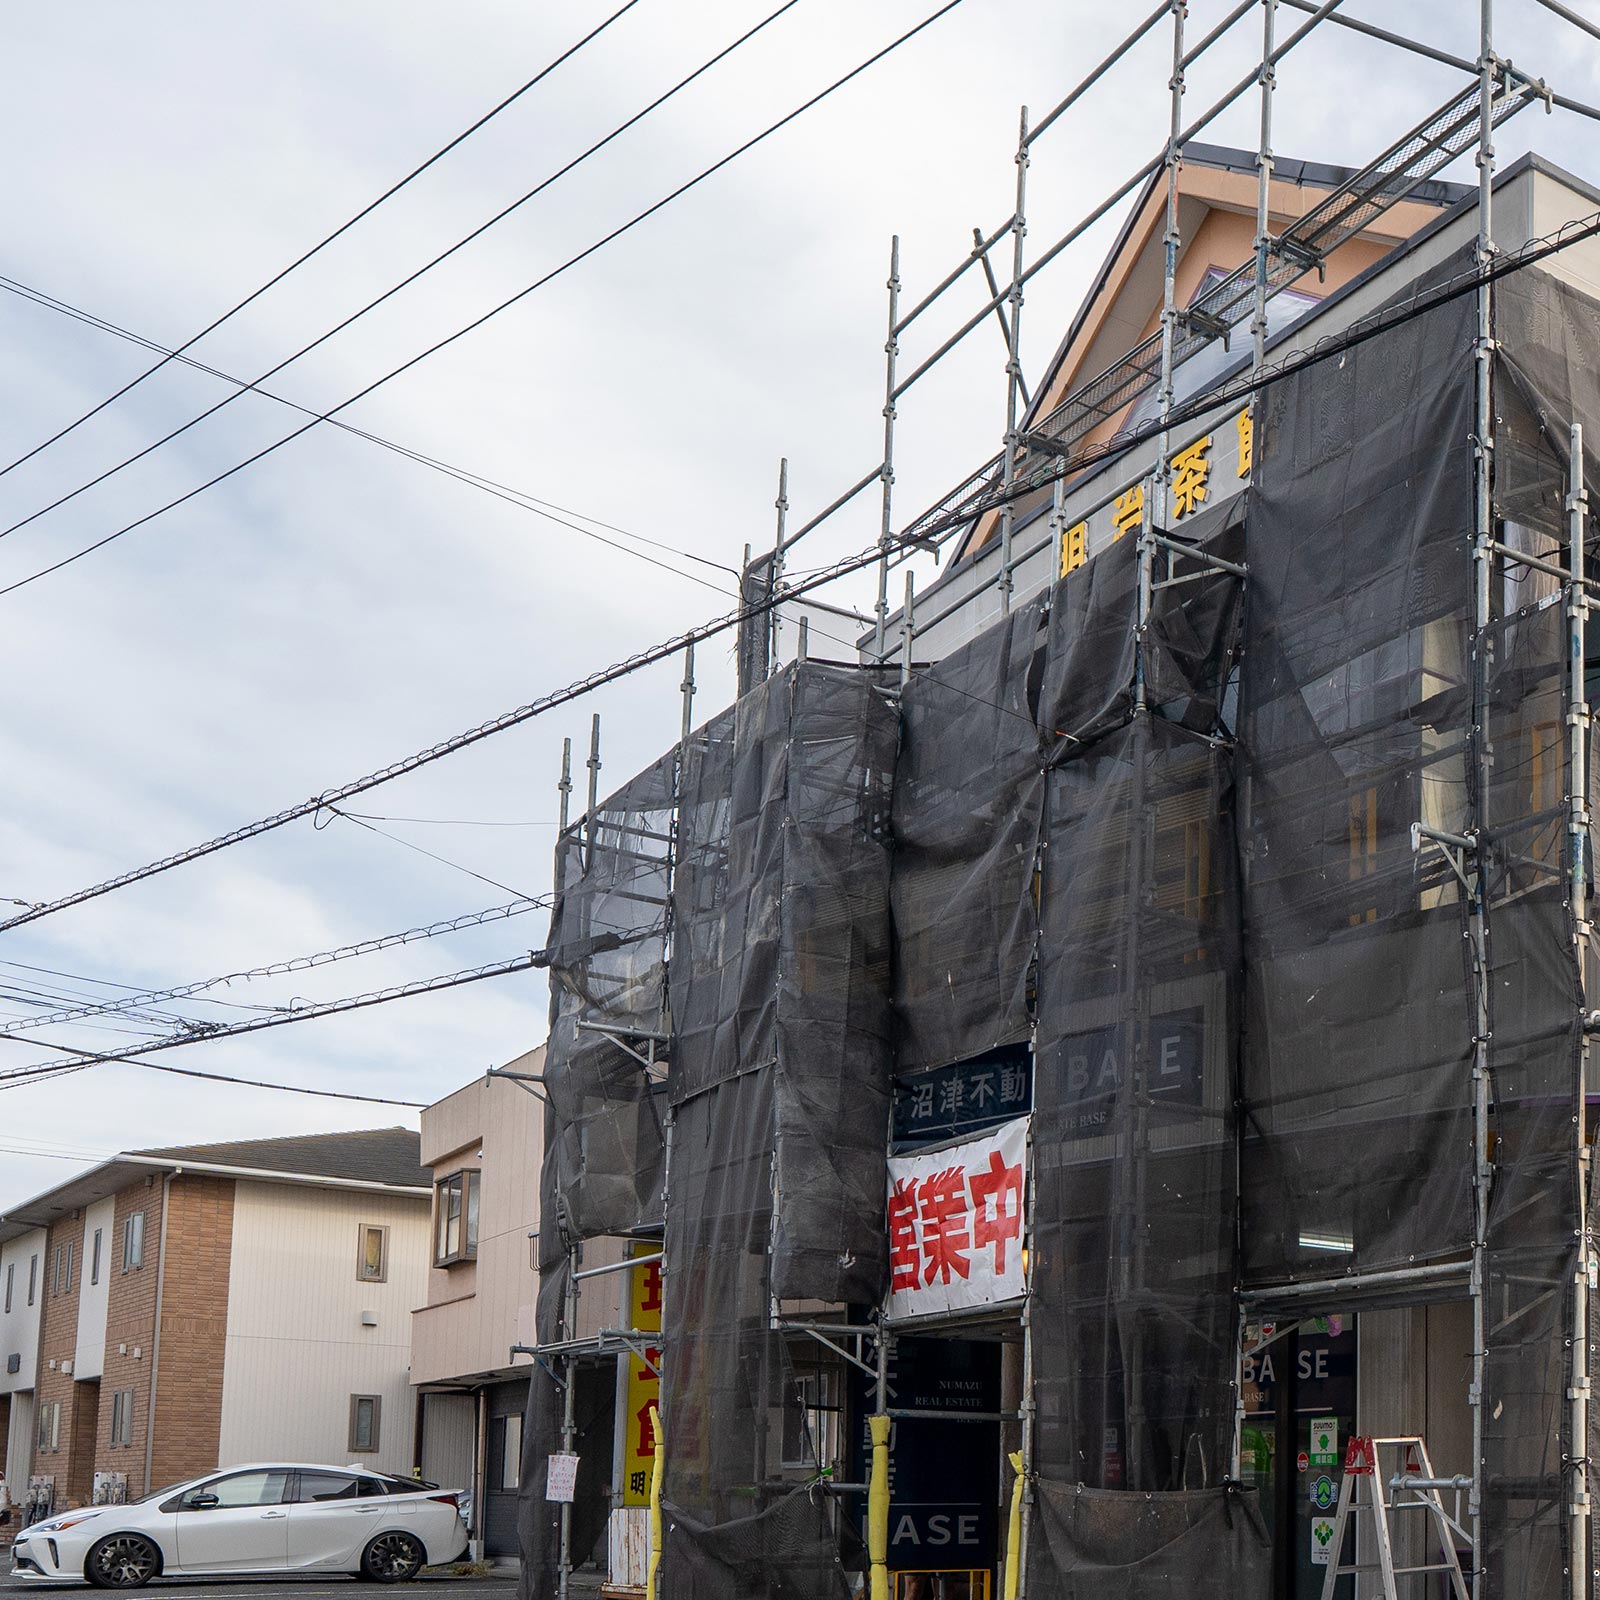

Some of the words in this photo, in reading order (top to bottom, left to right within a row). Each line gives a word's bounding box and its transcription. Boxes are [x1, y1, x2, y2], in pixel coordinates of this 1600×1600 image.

[910, 1065, 1027, 1119] 沼津不動
[889, 1151, 1022, 1295] 営業中
[939, 1380, 983, 1390] NUMAZU
[915, 1396, 942, 1406] REAL
[945, 1397, 983, 1407] ESTATE
